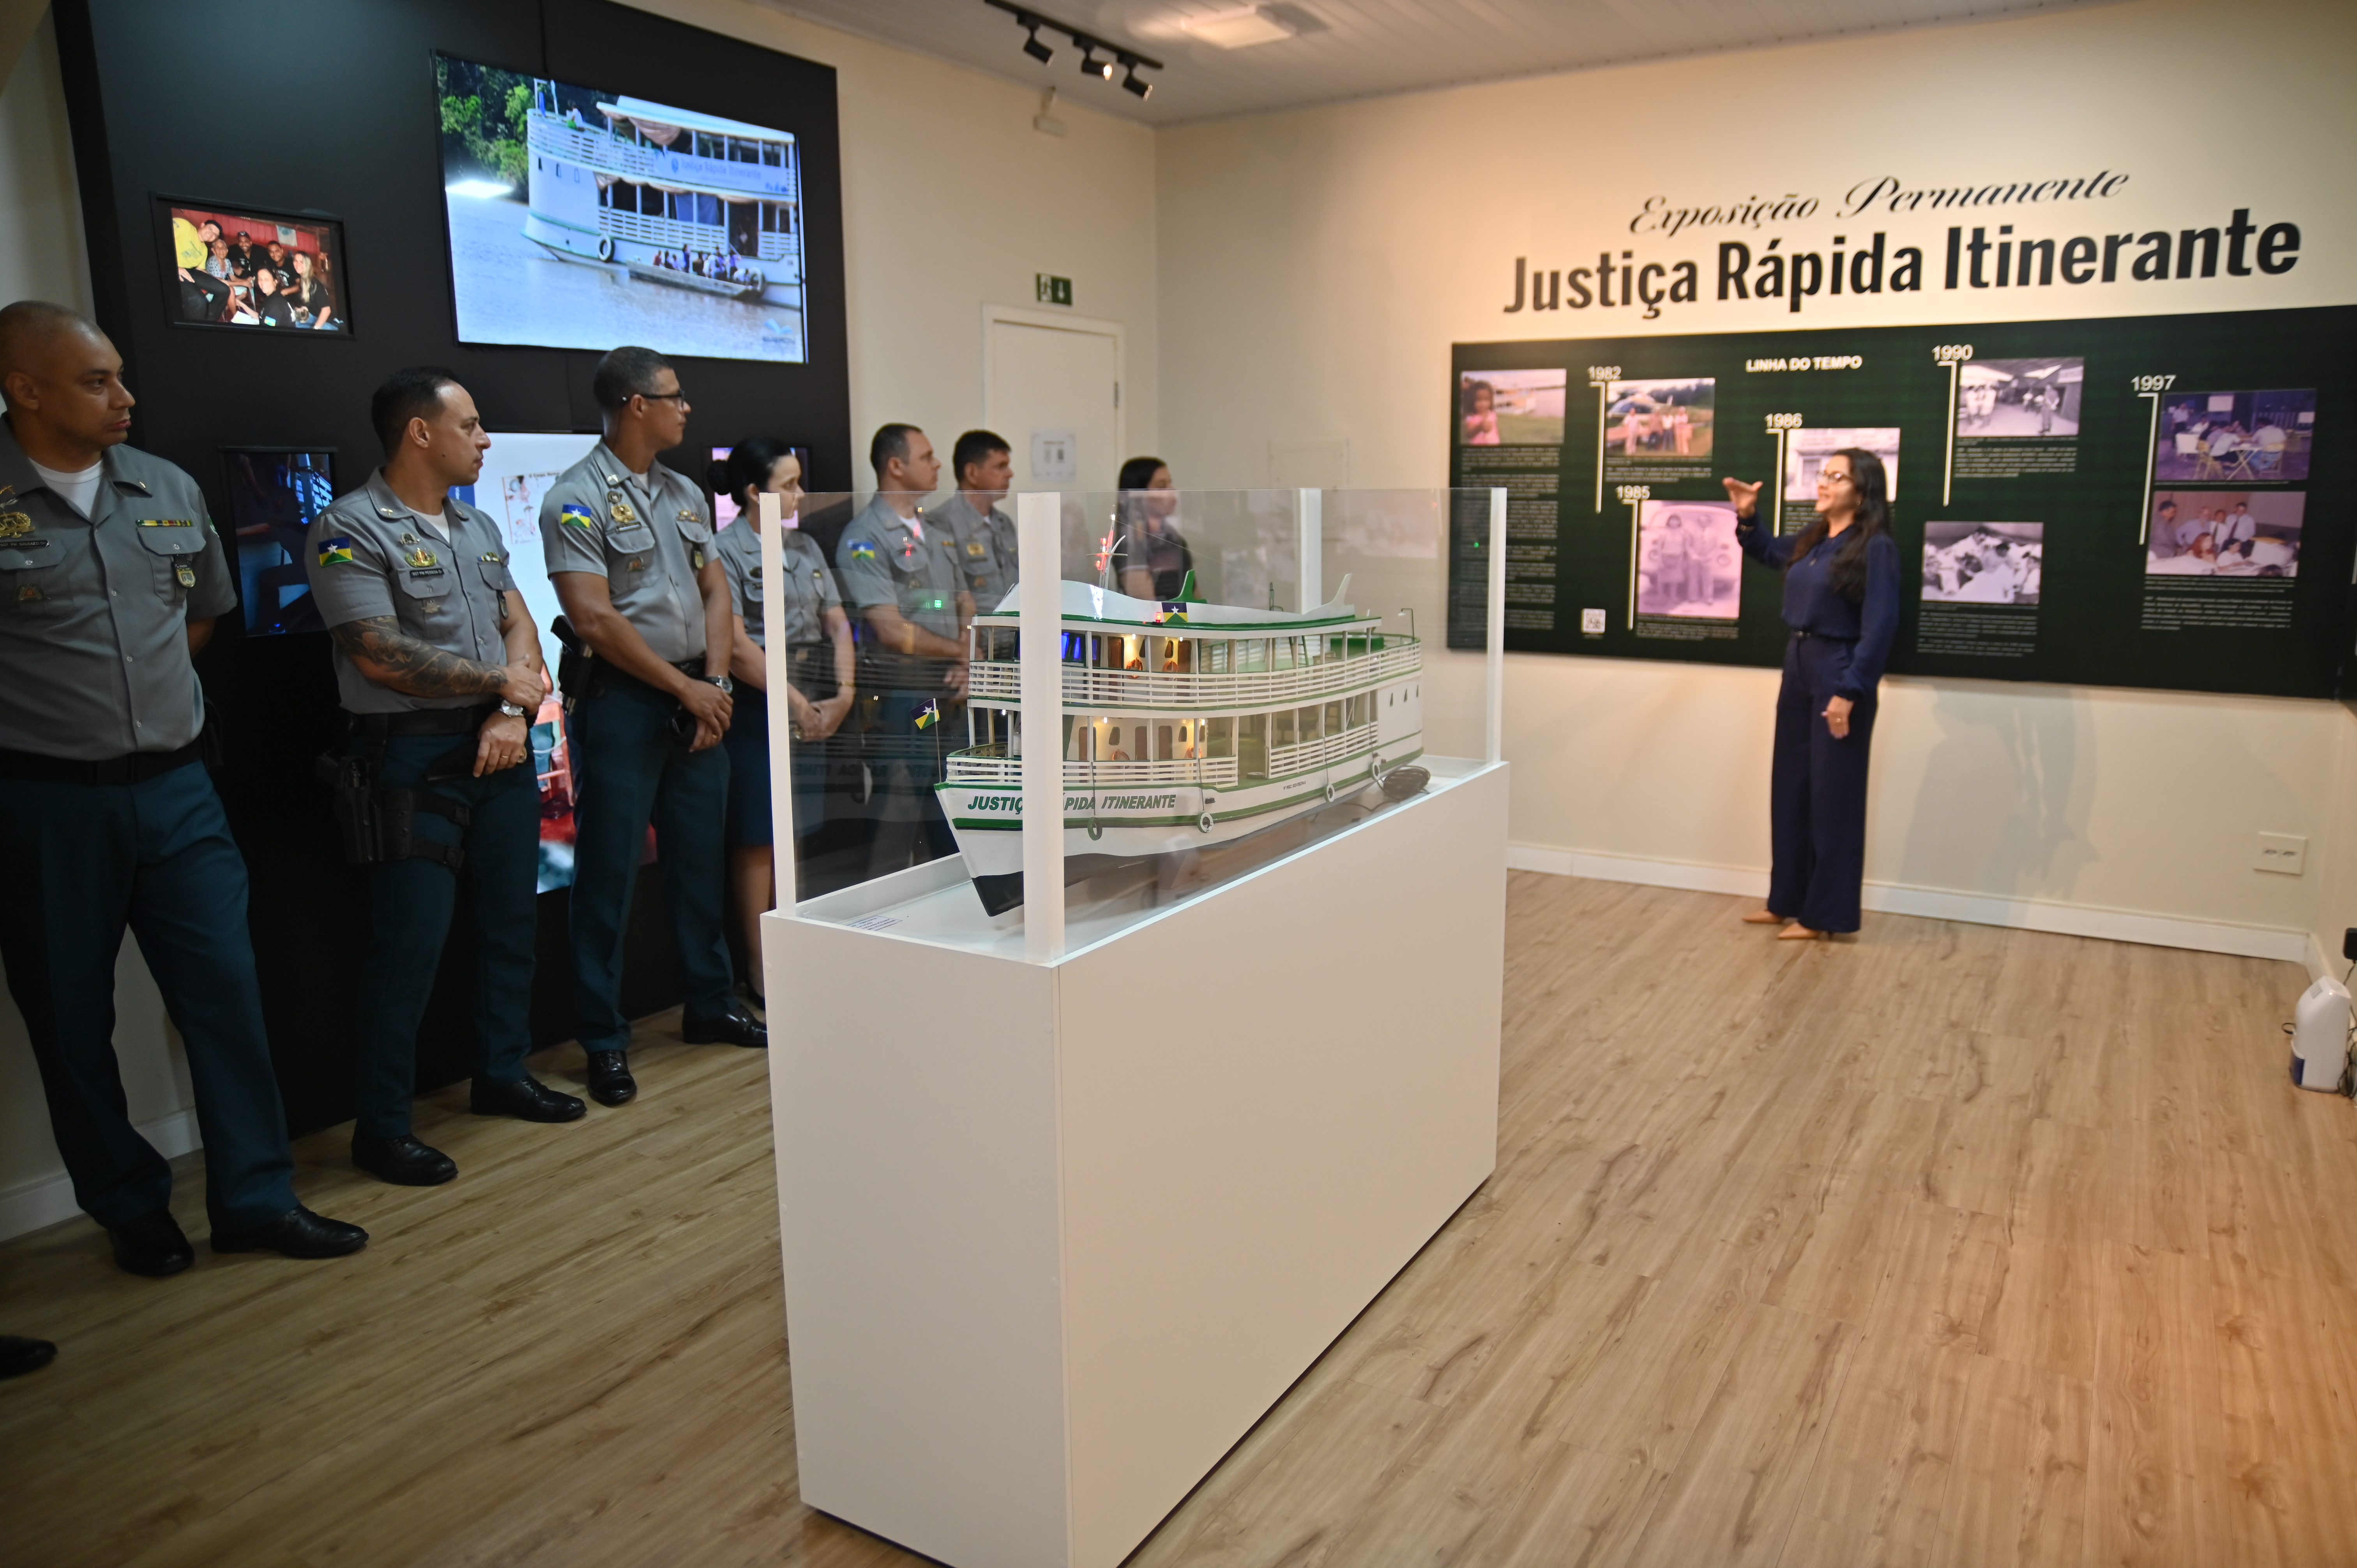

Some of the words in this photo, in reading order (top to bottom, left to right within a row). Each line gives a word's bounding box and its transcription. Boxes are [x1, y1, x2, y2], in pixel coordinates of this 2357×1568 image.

[1630, 194, 1819, 237] Exposição
[1836, 169, 2129, 219] Permanente
[1503, 250, 1698, 320] Justiça
[1717, 231, 1923, 313] Rápida
[1945, 208, 2302, 290] Itinerante
[1932, 344, 1974, 361] 1990
[1746, 358, 1788, 373] LINHA
[1788, 357, 1811, 371] DO
[1813, 355, 1863, 370] TEMPO
[1587, 366, 1622, 381] 1982
[2131, 374, 2177, 391] 1997
[1765, 413, 1803, 429] 1986
[1616, 485, 1650, 500] 1985
[967, 796, 1023, 815] JUSTIÇ
[1063, 792, 1095, 811] PIDA
[1101, 794, 1177, 809] ITINERANTE
